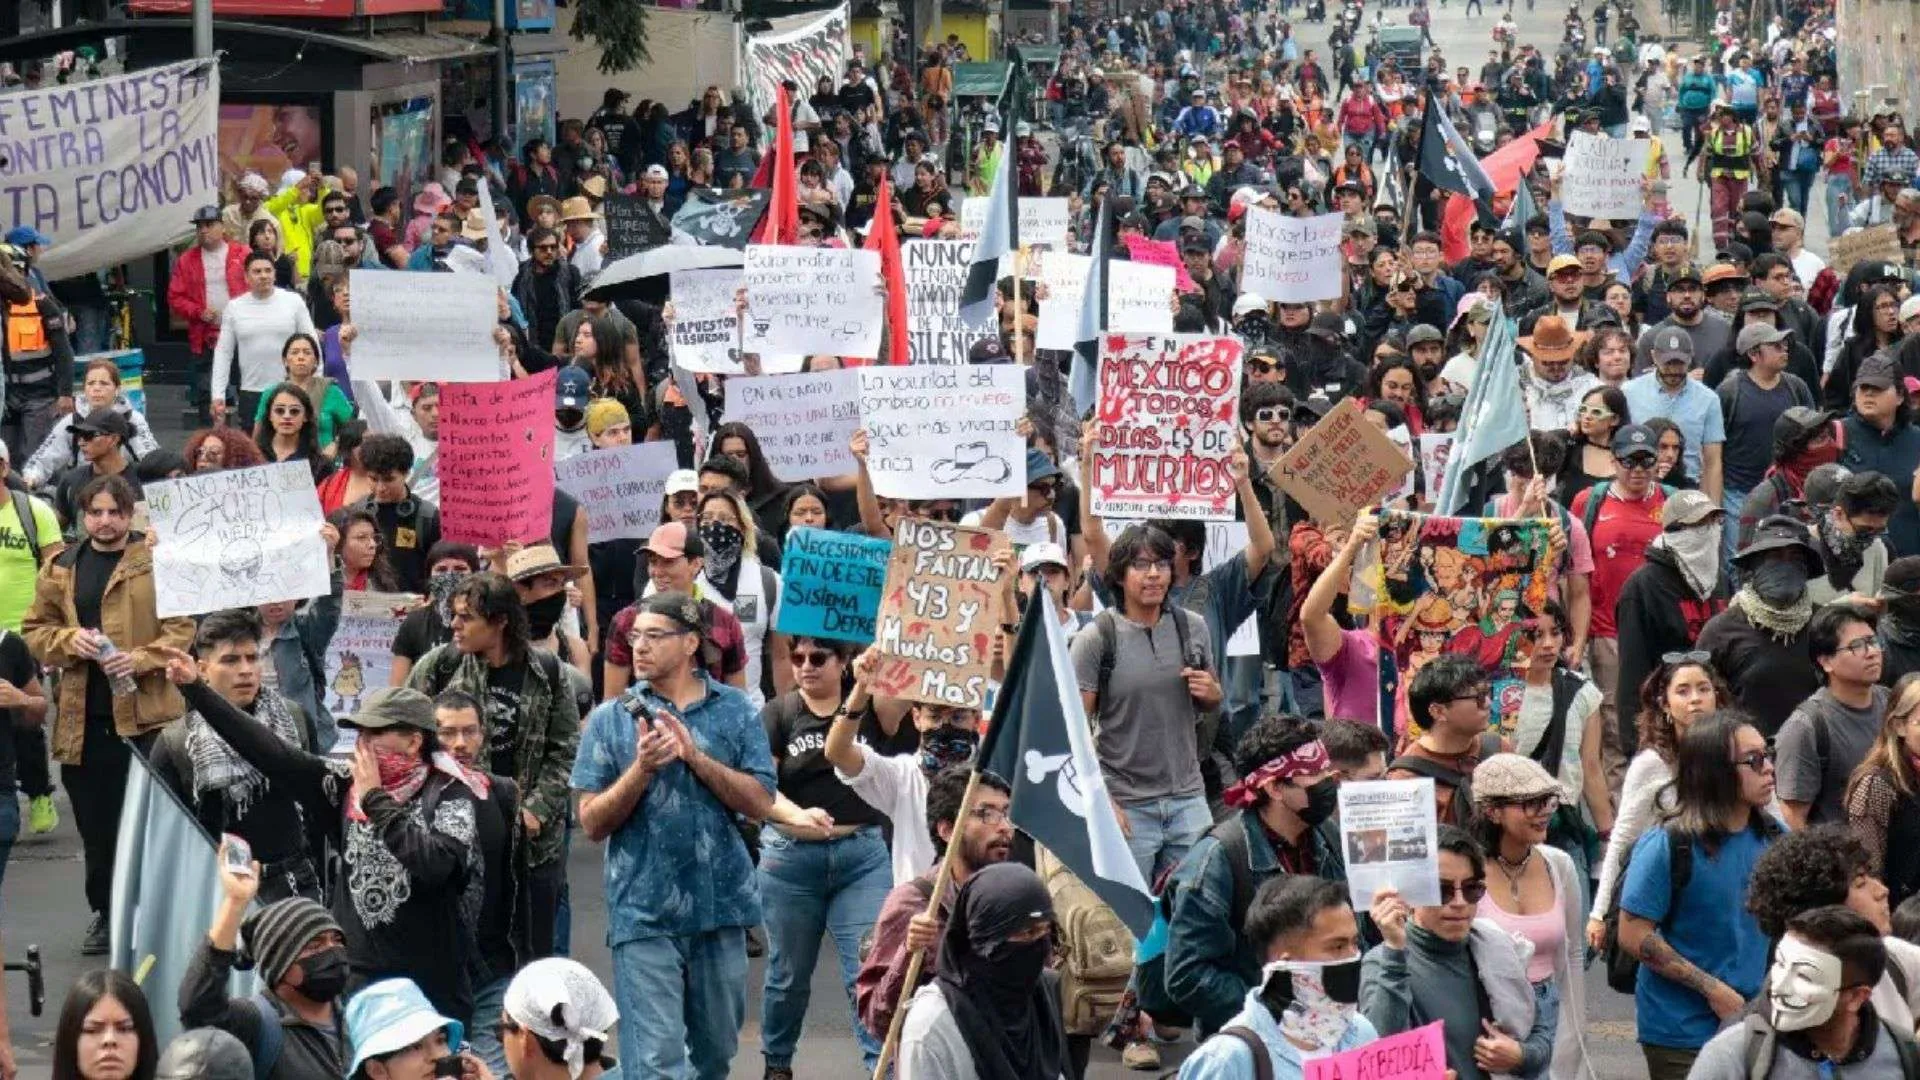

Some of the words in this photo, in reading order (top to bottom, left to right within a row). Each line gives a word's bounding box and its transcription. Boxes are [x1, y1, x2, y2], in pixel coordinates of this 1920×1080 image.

[139, 109, 181, 153] LA
[909, 242, 976, 268] NUNC
[907, 331, 998, 365] SILENC
[1145, 336, 1177, 353] EN
[968, 367, 994, 388] del
[1100, 352, 1233, 397] MÉXICO
[439, 387, 478, 407] Lista
[1129, 392, 1213, 418] TODOS
[450, 412, 487, 426] Narco
[1171, 427, 1194, 450] ES
[1202, 430, 1228, 452] DE
[1092, 450, 1237, 499] MUERTOS
[897, 518, 956, 551] NOS
[787, 556, 819, 578] FIN
[821, 560, 841, 581] DE
[841, 563, 883, 588] ESTE
[906, 578, 949, 619] 43
[787, 731, 825, 757] BOSS
